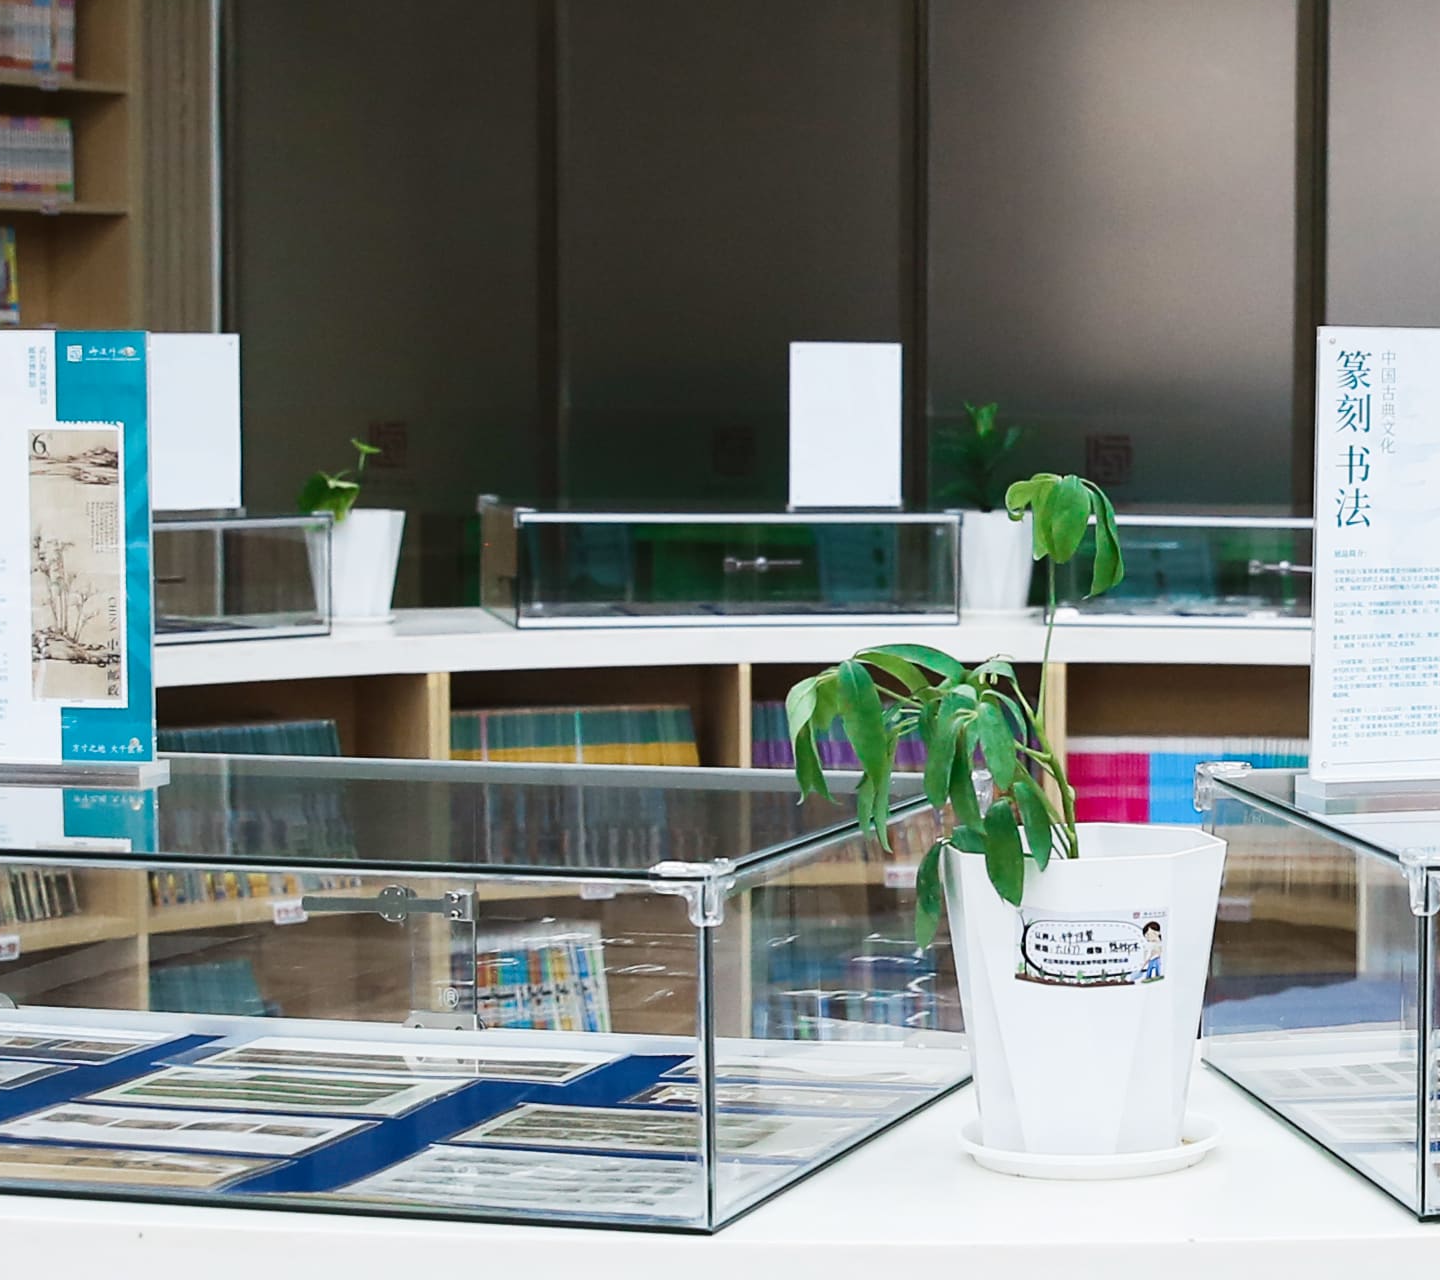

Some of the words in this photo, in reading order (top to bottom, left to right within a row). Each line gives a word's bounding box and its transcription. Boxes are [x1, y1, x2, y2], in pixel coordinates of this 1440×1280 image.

[1336, 350, 1372, 433] 篆刻
[1380, 350, 1396, 454] 中国古典文化
[1336, 445, 1371, 528] 书法
